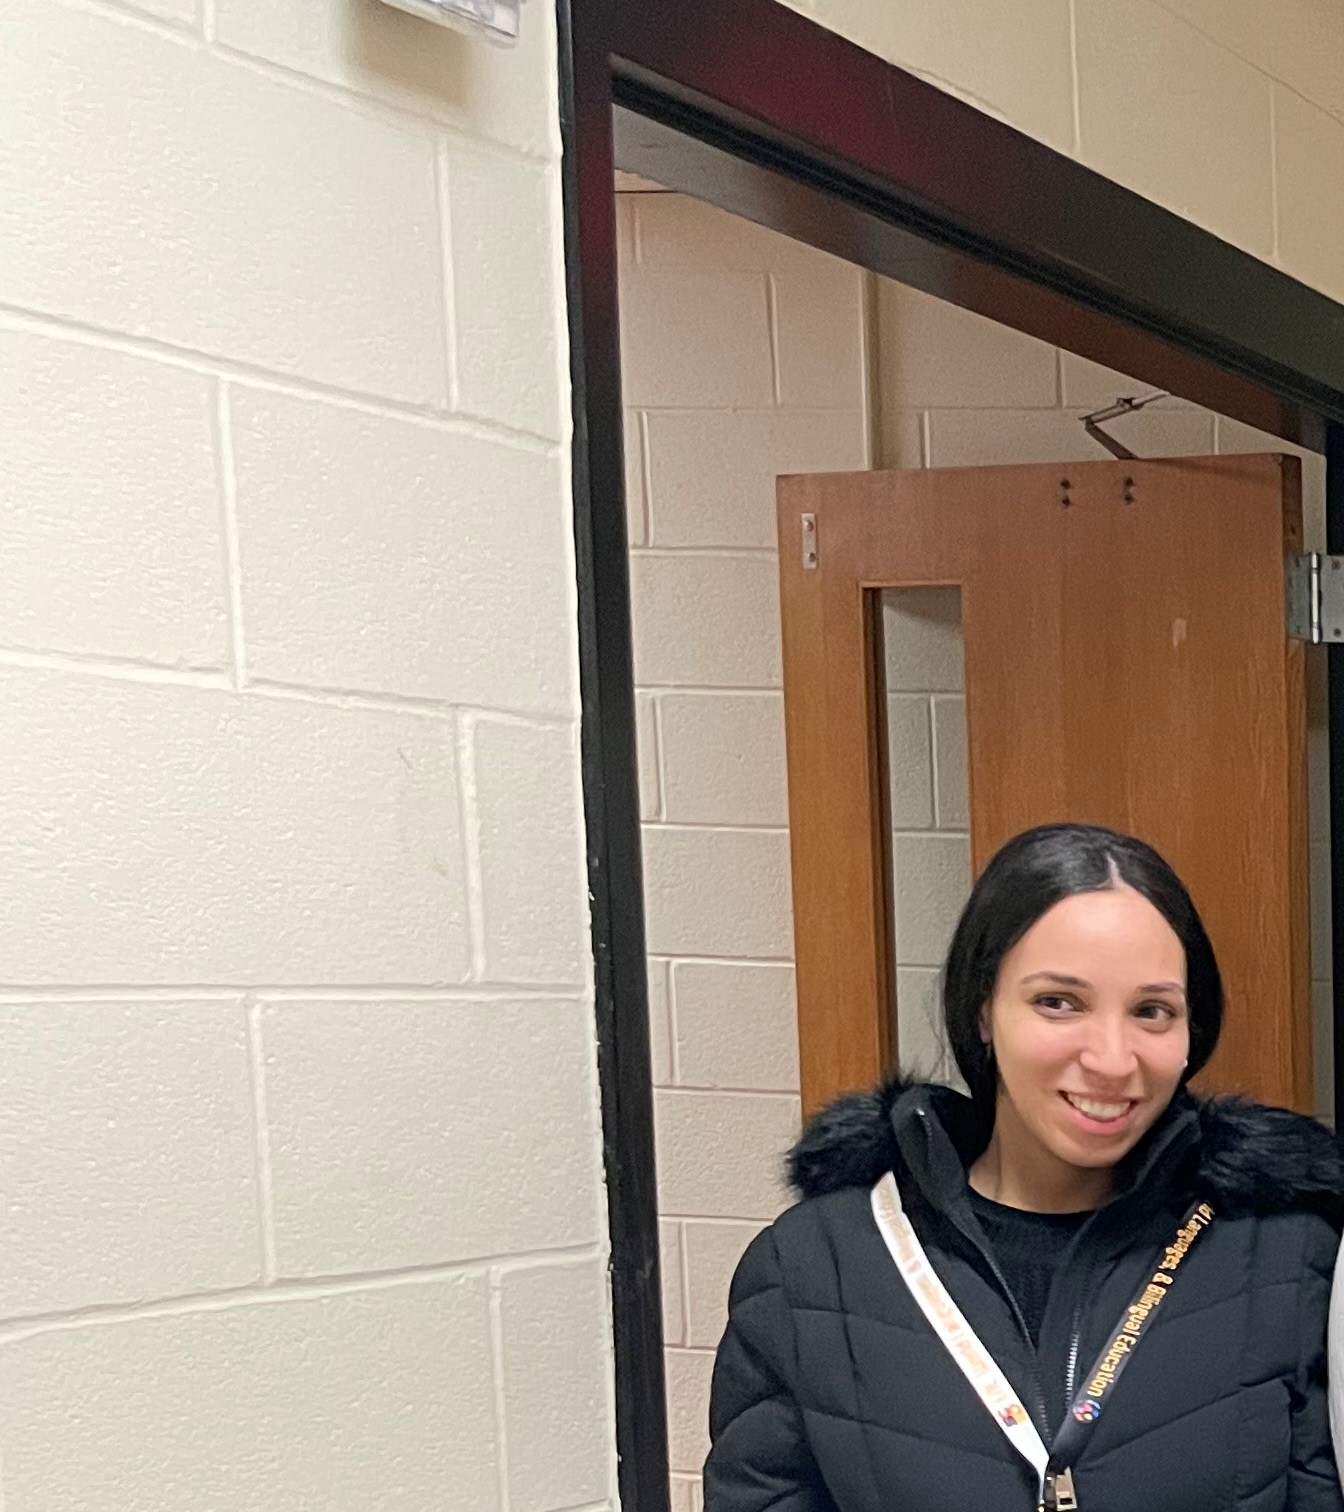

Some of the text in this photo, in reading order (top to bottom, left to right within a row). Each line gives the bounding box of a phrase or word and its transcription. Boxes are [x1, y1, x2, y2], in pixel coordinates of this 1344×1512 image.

[1158, 1213, 1210, 1271] Languages,
[1152, 1272, 1174, 1285] &
[1128, 1283, 1167, 1336] Bilingual
[1087, 1334, 1137, 1398] Education
